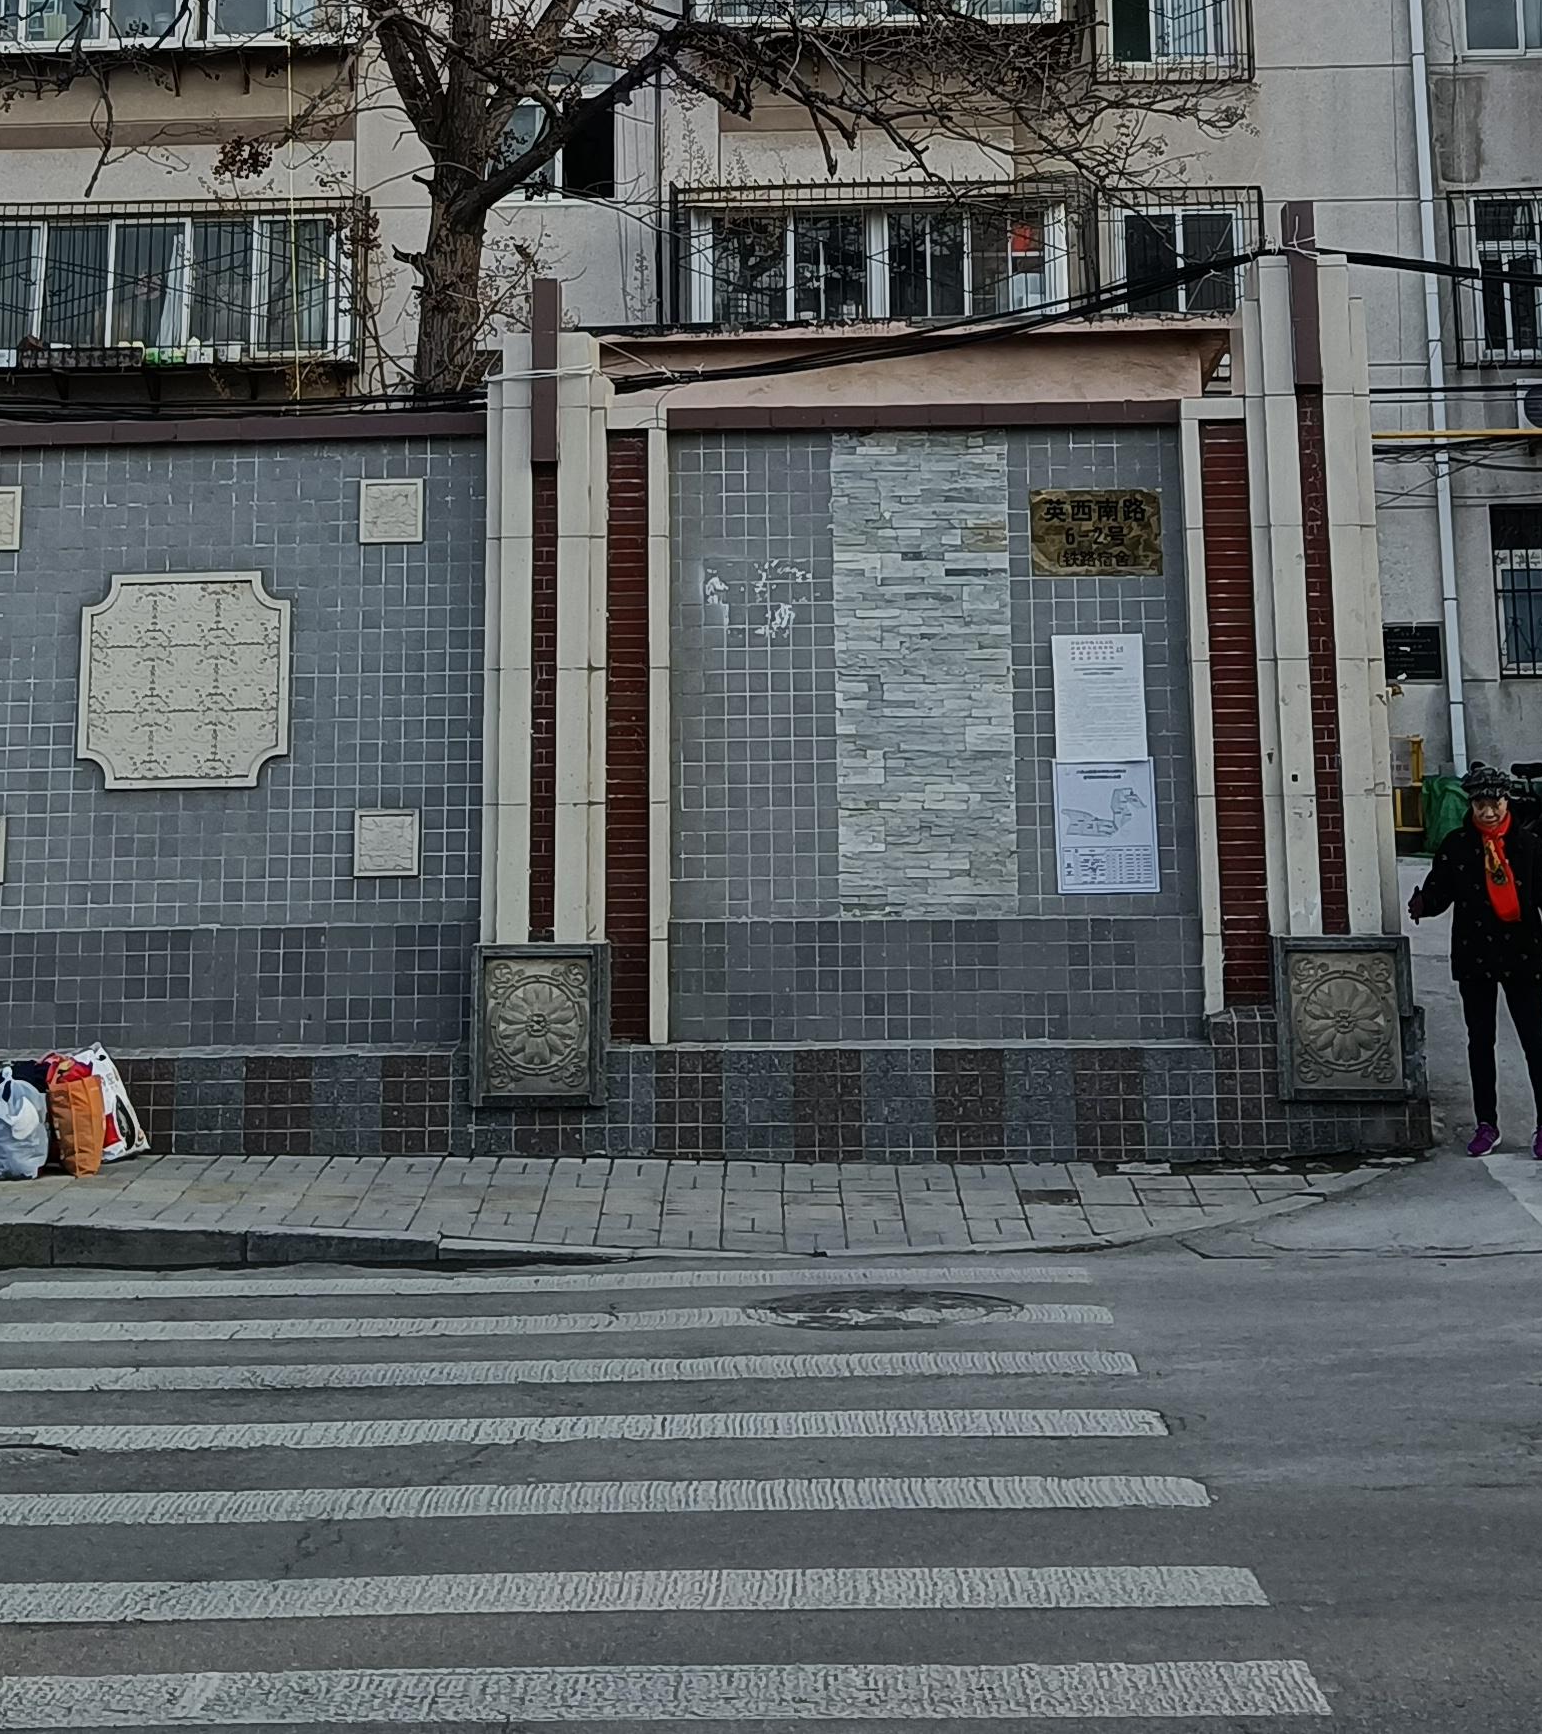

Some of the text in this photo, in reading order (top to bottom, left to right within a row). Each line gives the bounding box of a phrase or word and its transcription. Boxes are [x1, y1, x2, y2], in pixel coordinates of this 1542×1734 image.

[1043, 498, 1147, 522] 英西南路
[1065, 526, 1127, 547] 6-2号
